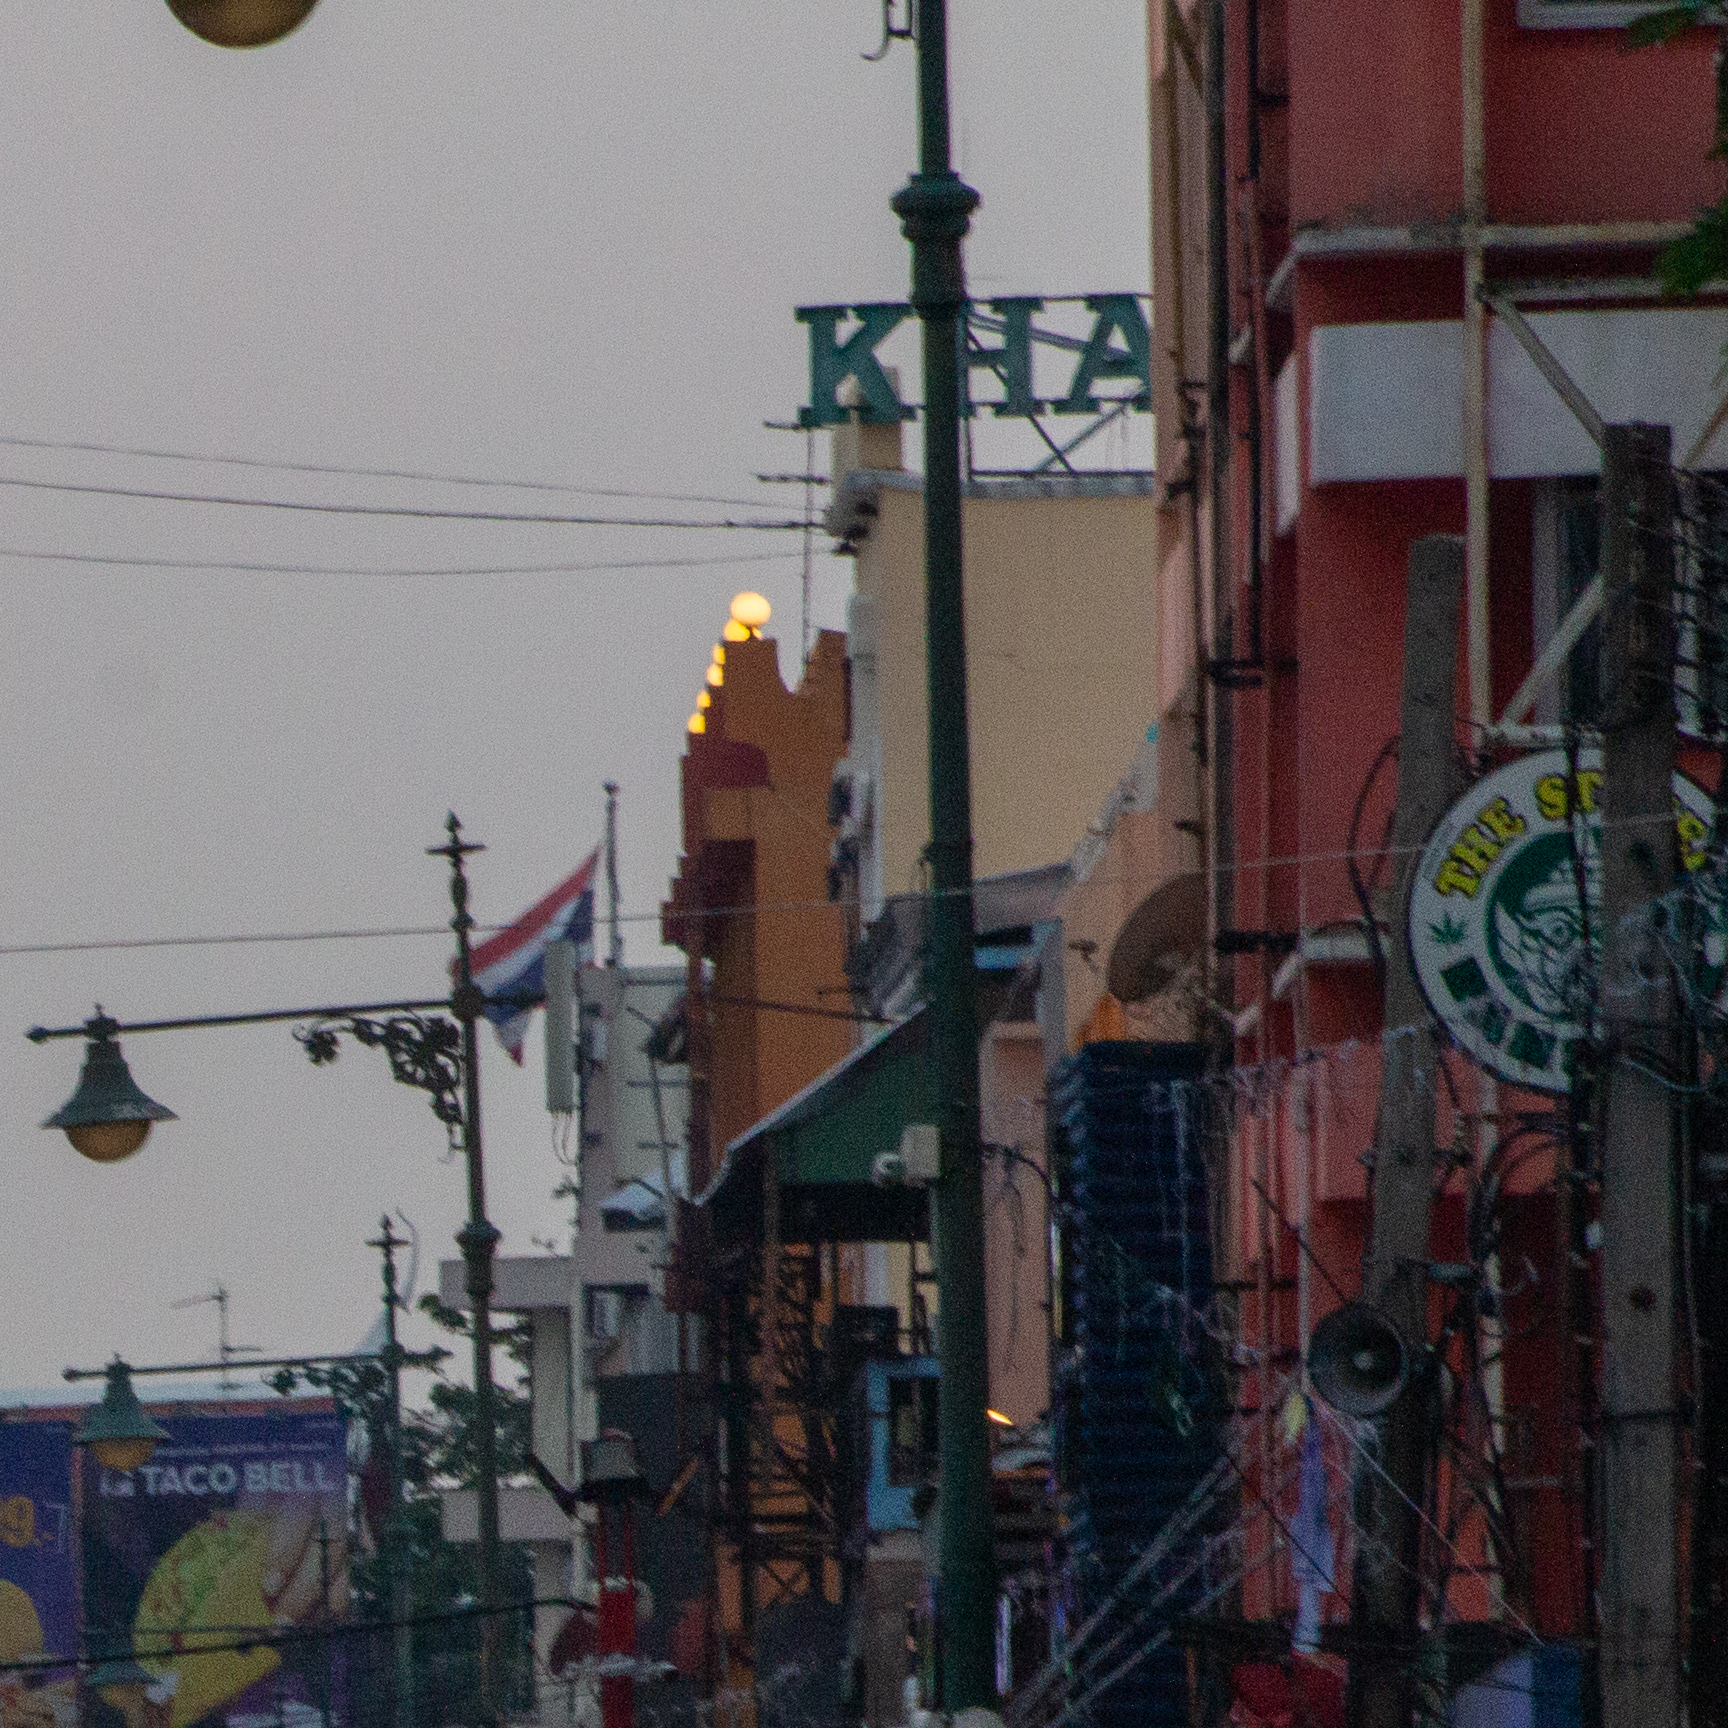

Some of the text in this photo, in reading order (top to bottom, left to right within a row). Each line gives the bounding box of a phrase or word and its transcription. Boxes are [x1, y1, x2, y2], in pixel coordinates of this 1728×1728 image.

[1435, 796, 1527, 897] THE
[138, 1461, 335, 1497] TACO BELL
